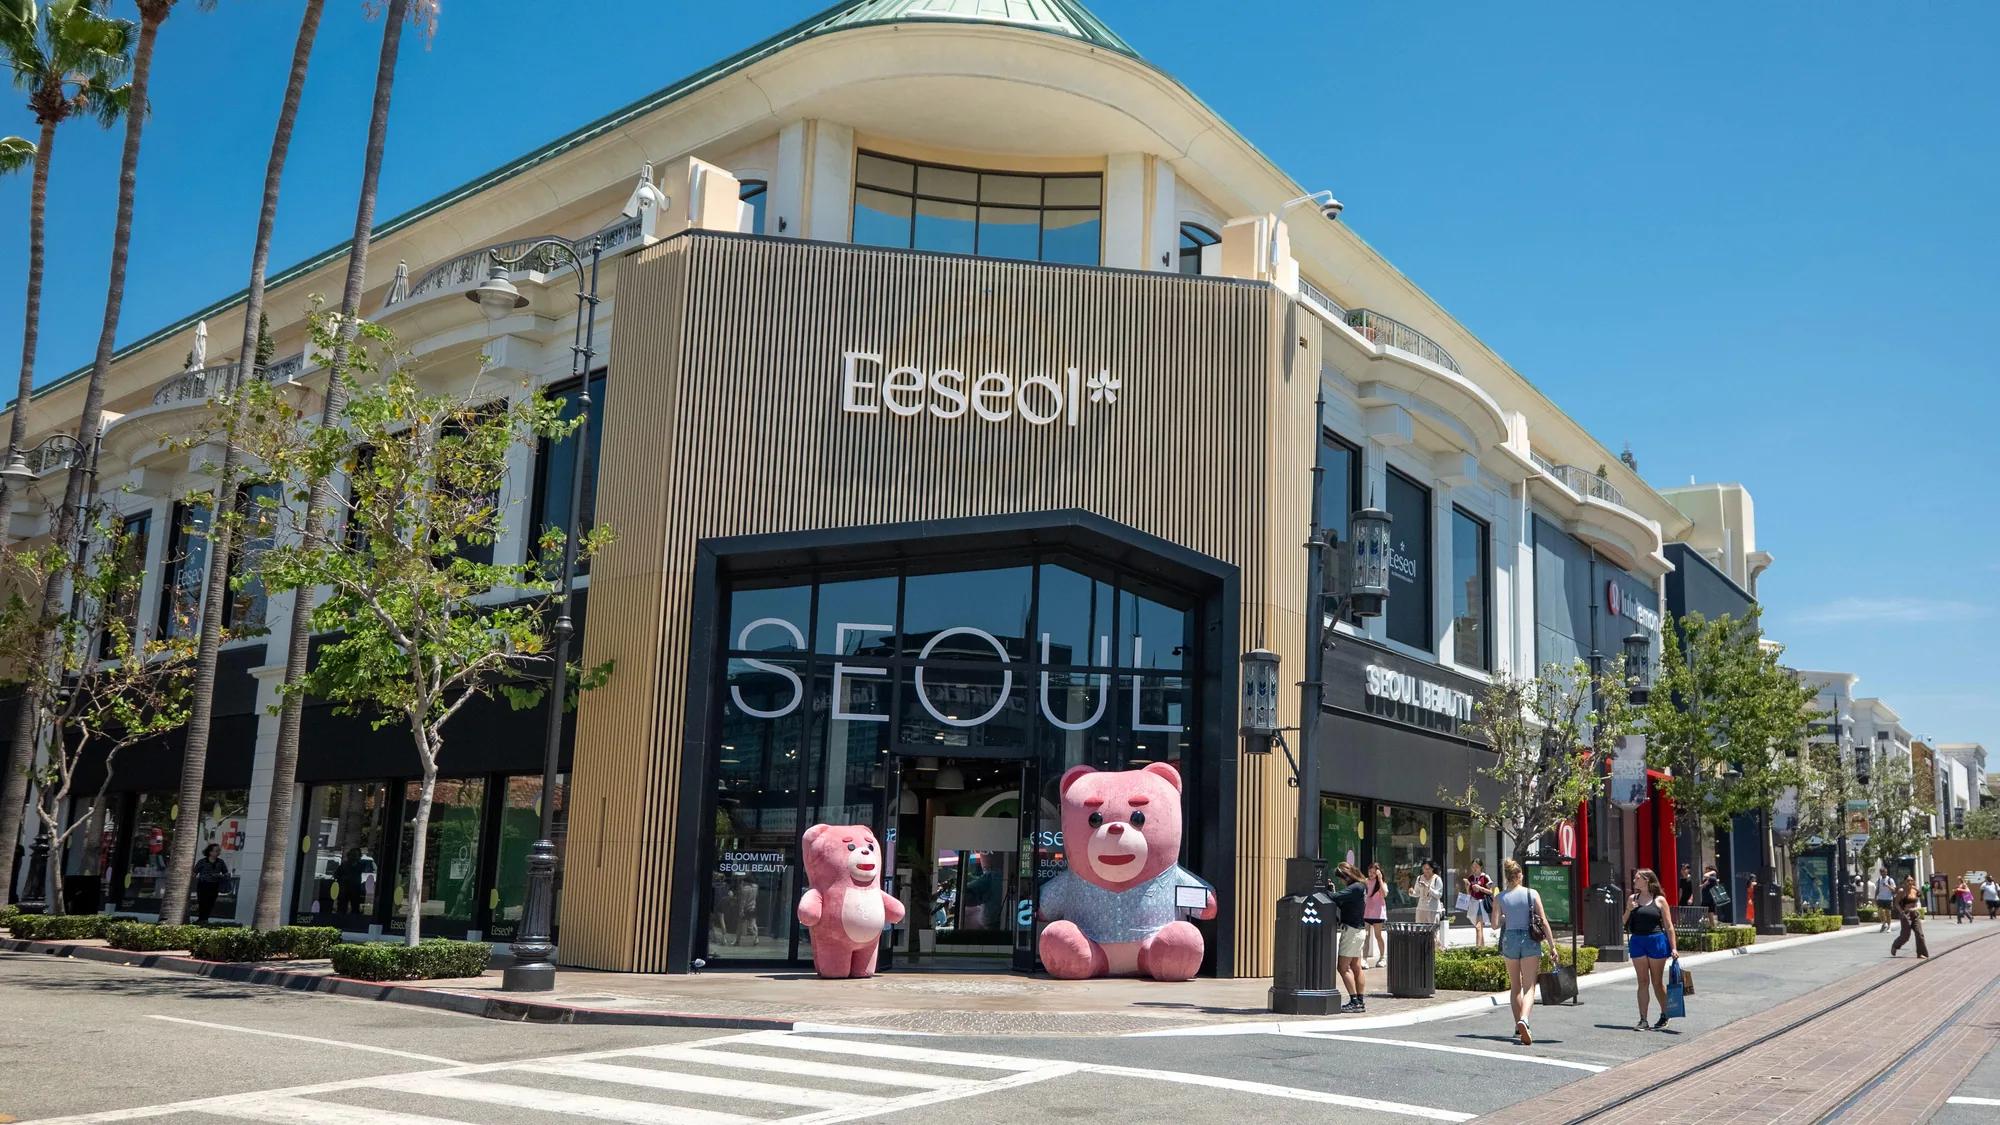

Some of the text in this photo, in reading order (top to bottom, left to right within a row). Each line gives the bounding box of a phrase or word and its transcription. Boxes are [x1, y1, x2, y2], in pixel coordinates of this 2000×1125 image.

[843, 351, 1078, 426] Eeseol
[1621, 588, 1659, 633] lululemon
[731, 617, 1184, 732] SEOUL
[1365, 664, 1474, 722] SEOUL BEAUTY
[719, 863, 788, 873] SEOUL BEAUTY
[725, 852, 784, 862] BLOOM WITH
